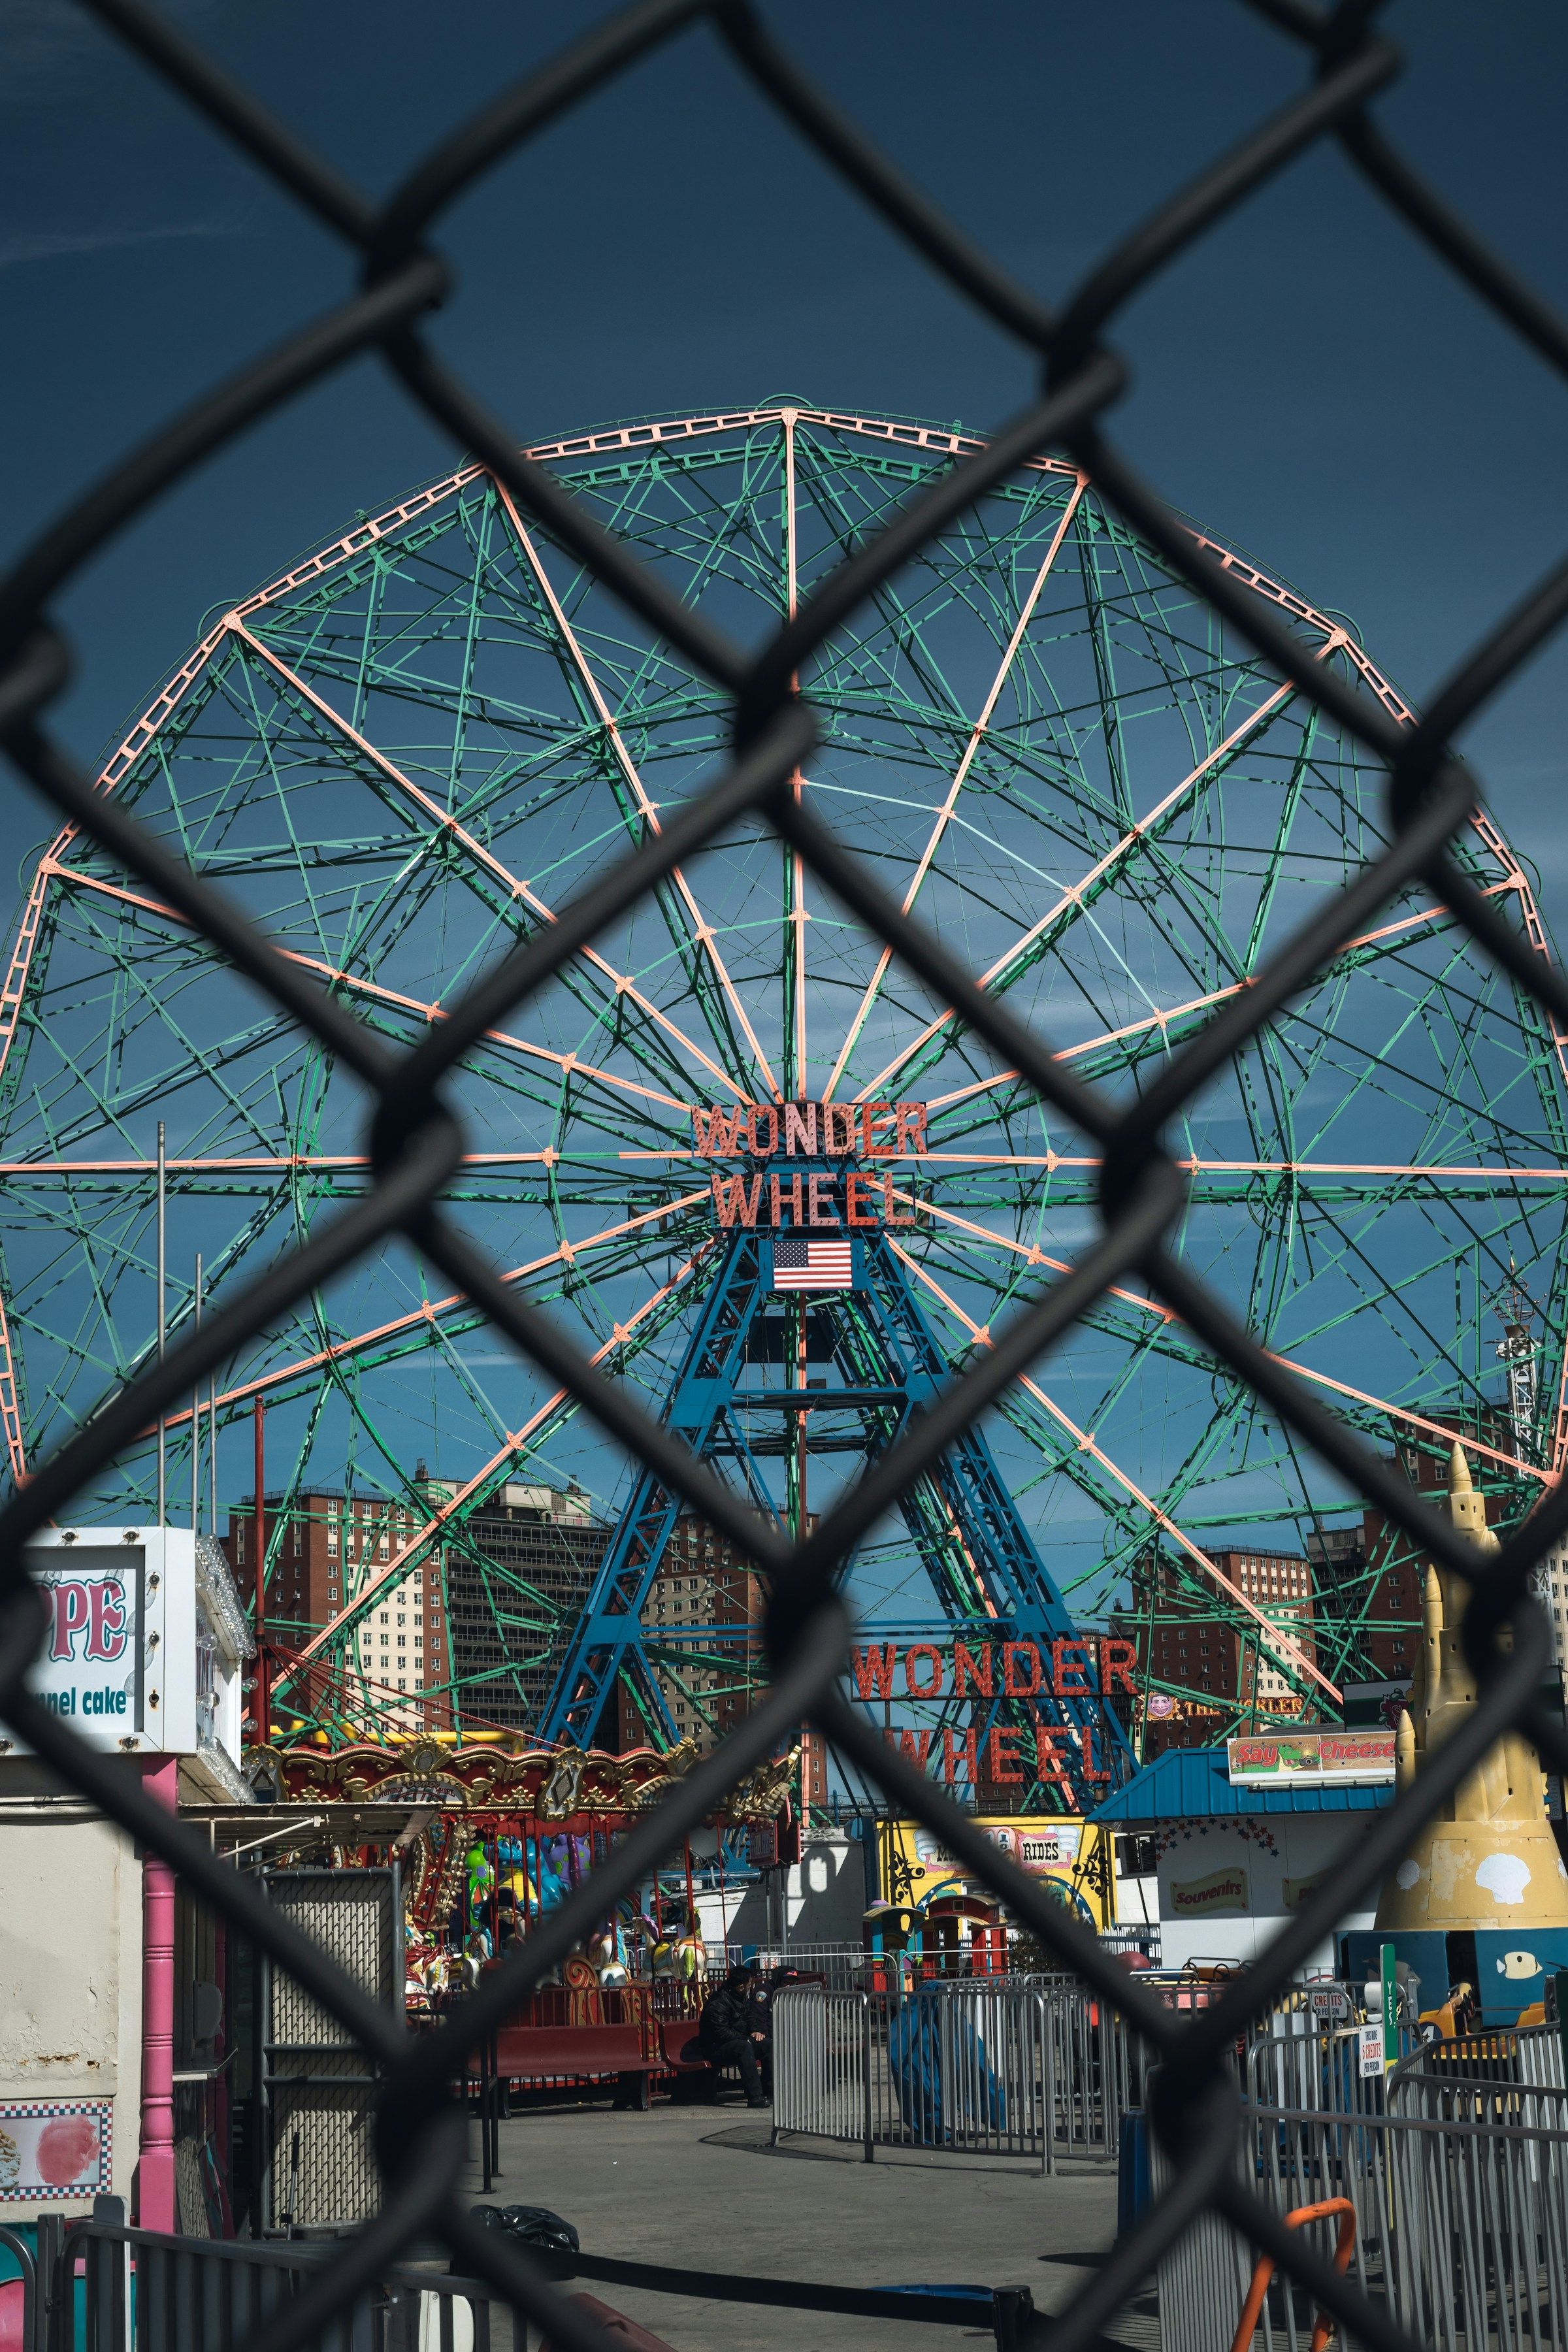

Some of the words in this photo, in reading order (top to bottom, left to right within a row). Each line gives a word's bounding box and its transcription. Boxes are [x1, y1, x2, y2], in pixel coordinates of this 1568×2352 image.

[691, 1102, 928, 1158] WONDER
[711, 1172, 916, 1228] WHEEL
[852, 1639, 1139, 1700] WONDER
[83, 1686, 127, 1715] cake
[884, 1725, 1111, 1784] WHEEL
[1236, 1744, 1279, 1767] Say
[1316, 1740, 1396, 1760] Cheese
[1022, 1842, 1059, 1861] RIDES
[1175, 1880, 1242, 1904] Souvenirs
[1315, 1995, 1342, 2006] CREITS
[1365, 2042, 1381, 2059] CREDITS
[1369, 2061, 1380, 2072] PERSON
